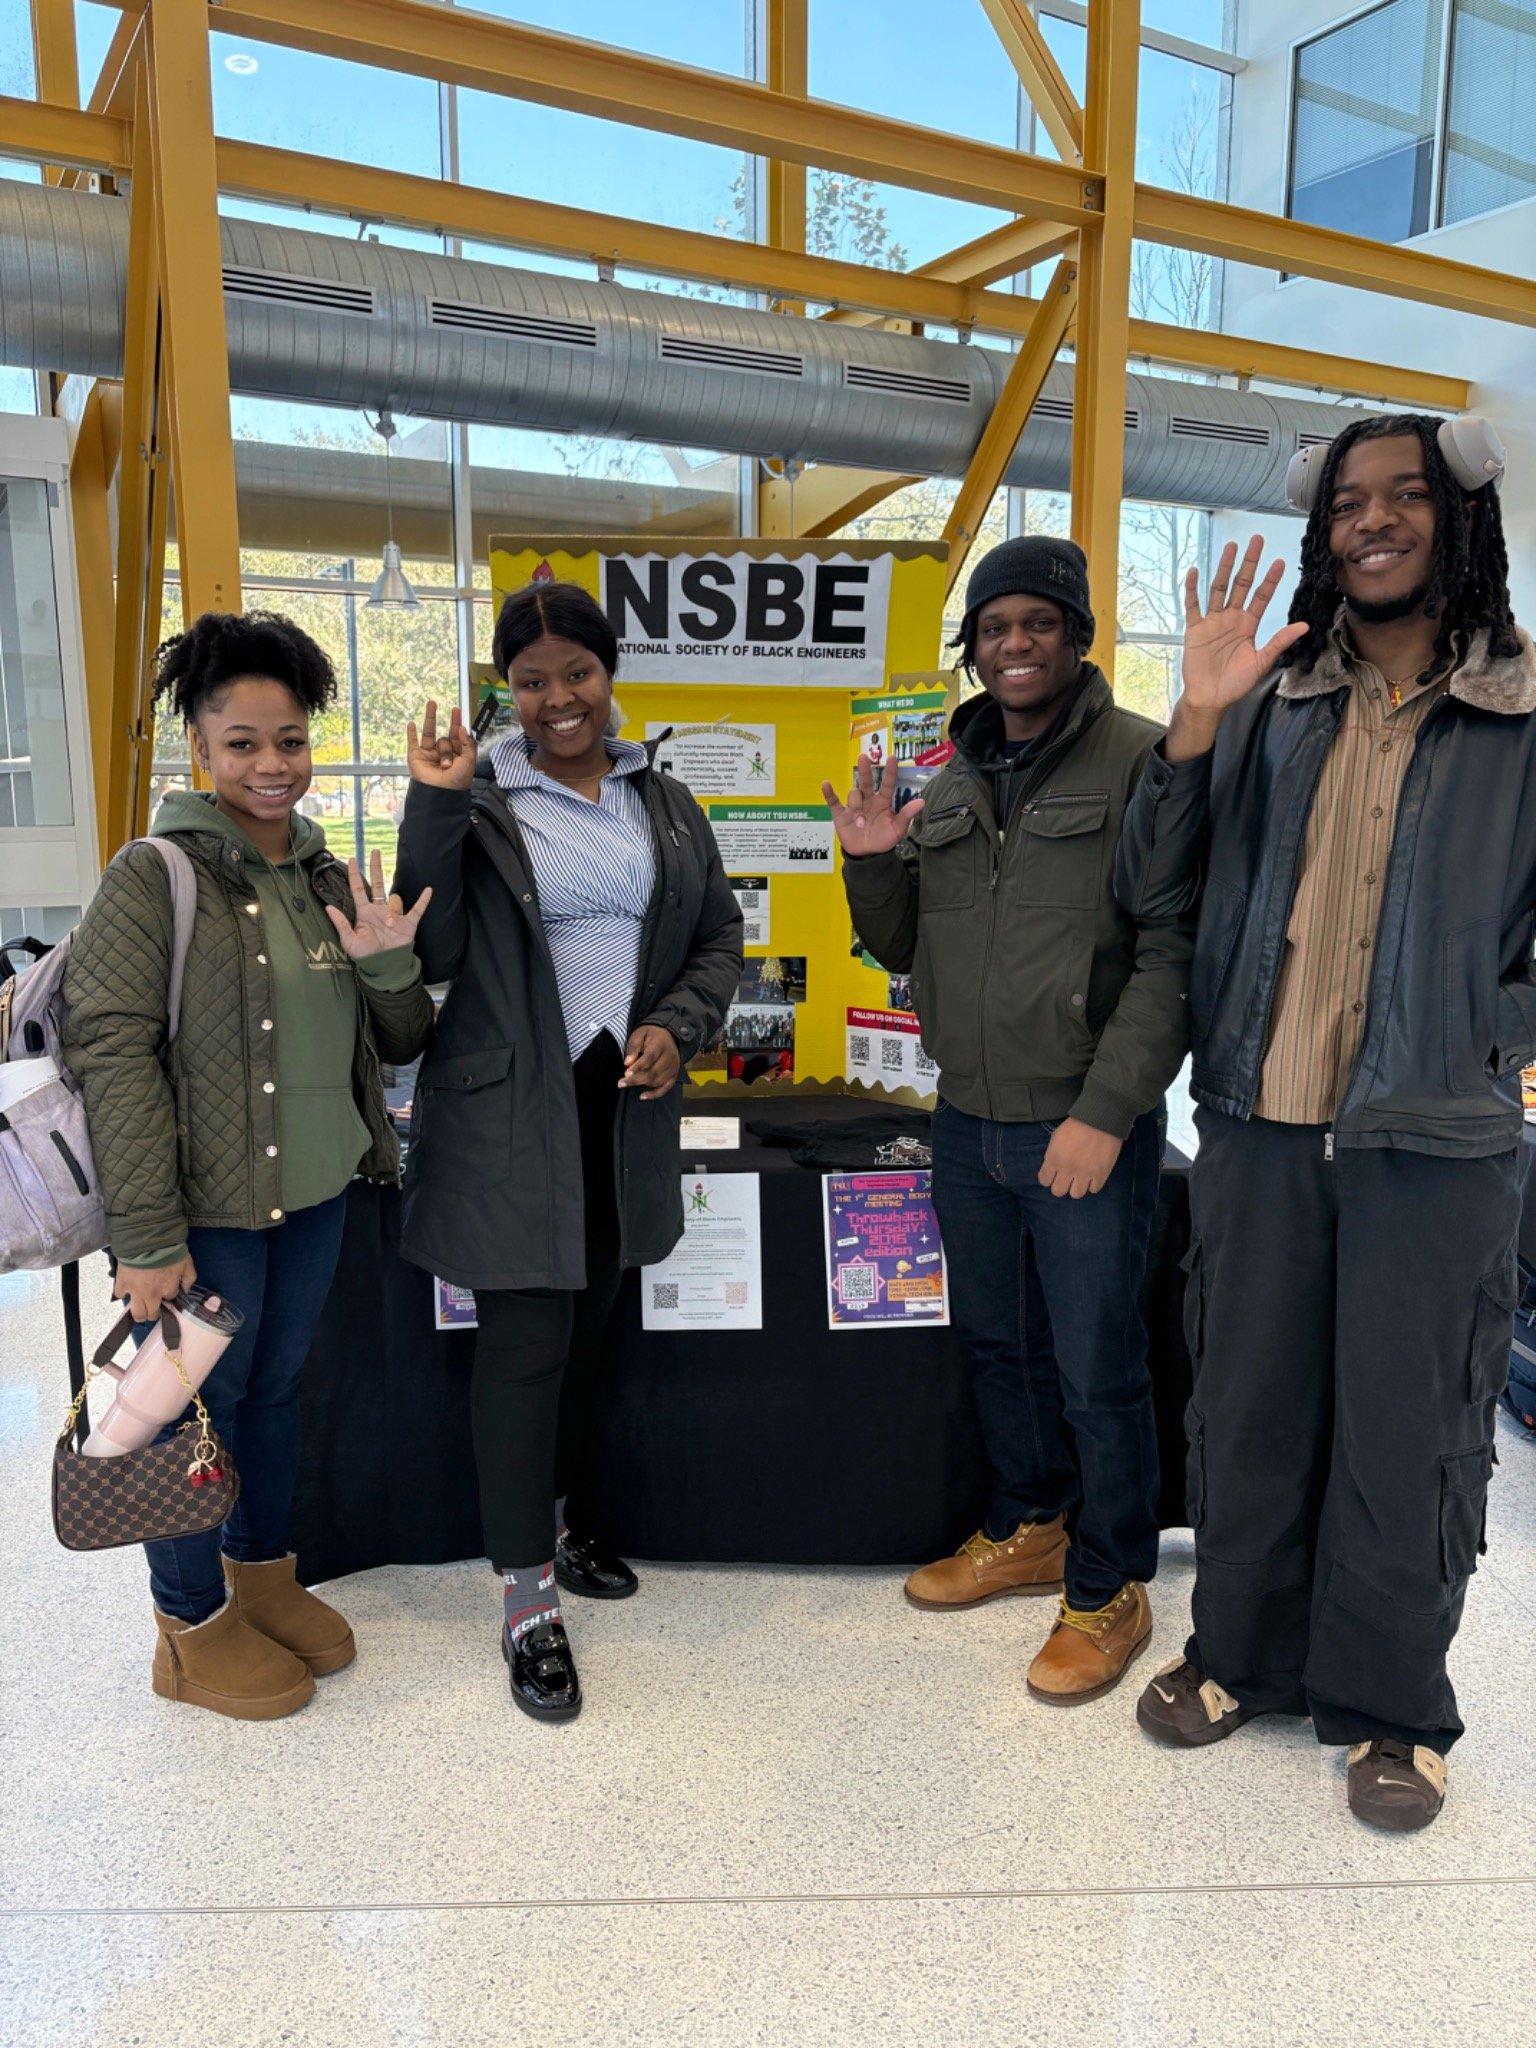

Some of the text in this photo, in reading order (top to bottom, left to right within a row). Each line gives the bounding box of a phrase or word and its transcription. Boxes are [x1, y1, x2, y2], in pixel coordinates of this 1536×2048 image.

[605, 560, 869, 643] NSBE
[617, 643, 866, 659] ATIONAL SOCIETY OF BLACK ENGINEERS
[878, 700, 895, 709] WHAT
[746, 811, 771, 820] ABOUT
[852, 1011, 875, 1020] FOLLOW
[846, 1210, 928, 1224] Throwback
[864, 1246, 912, 1257] edition
